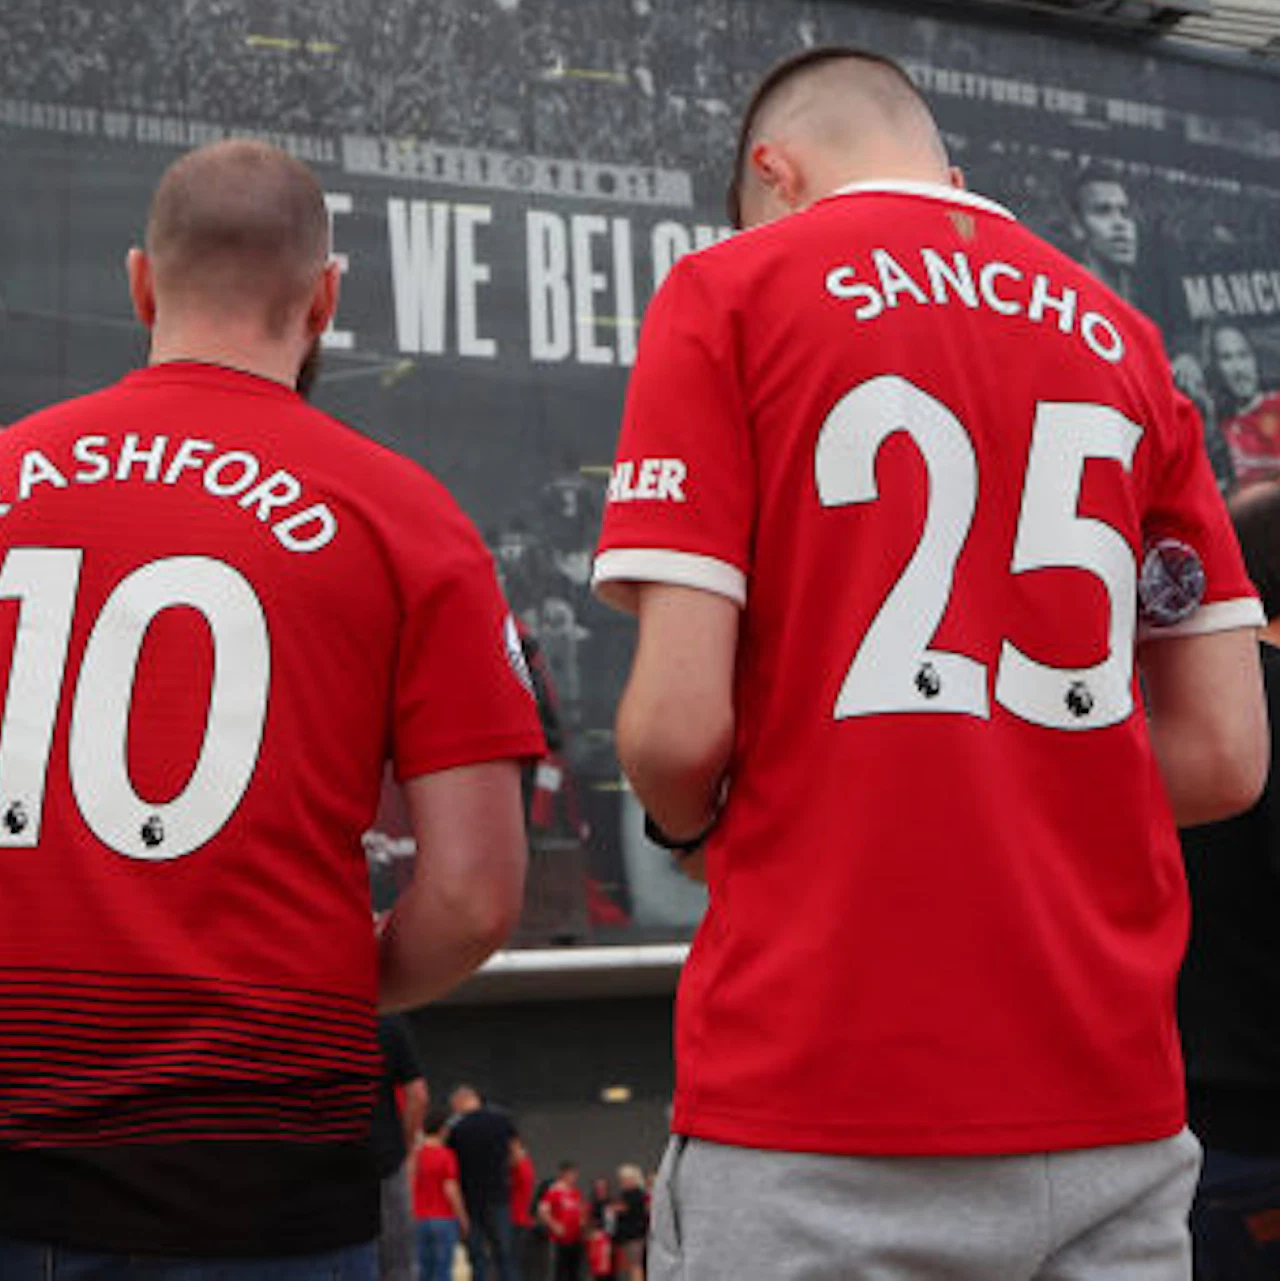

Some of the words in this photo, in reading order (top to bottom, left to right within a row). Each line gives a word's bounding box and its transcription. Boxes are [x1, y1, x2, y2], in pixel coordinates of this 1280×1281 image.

[388, 198, 496, 358] WE
[826, 248, 1125, 363] SANCHO
[815, 374, 1144, 731] 25
